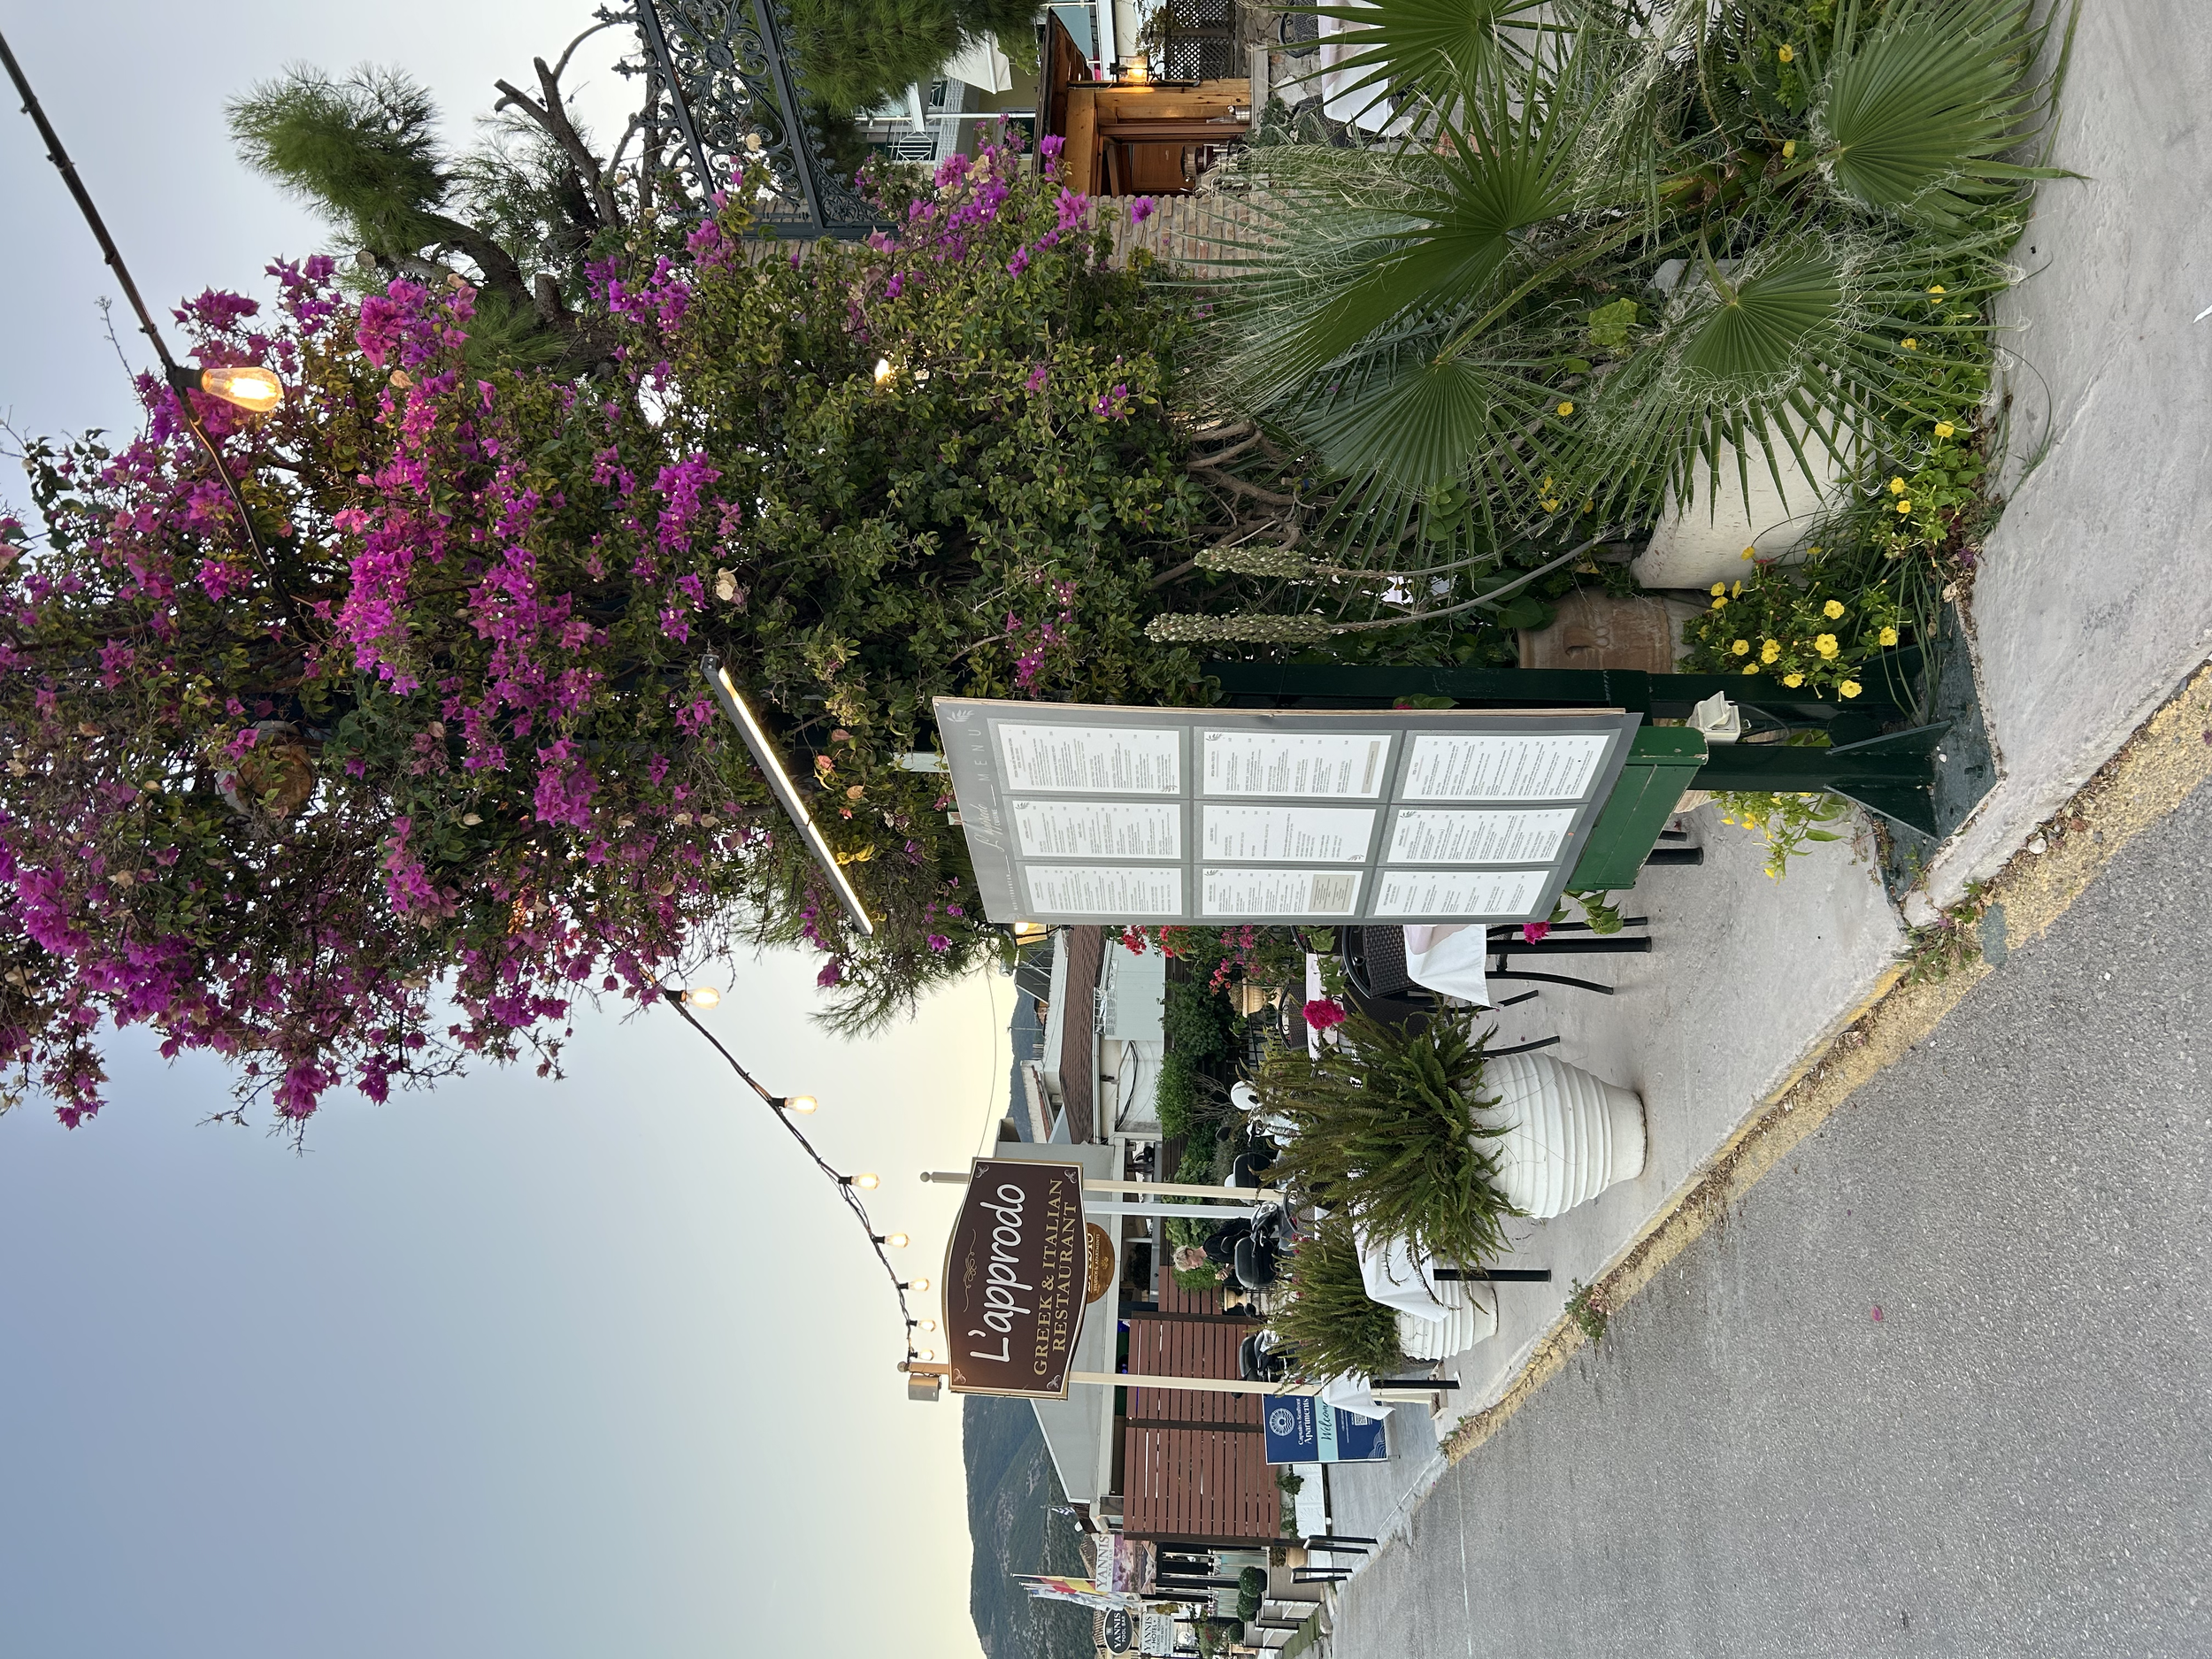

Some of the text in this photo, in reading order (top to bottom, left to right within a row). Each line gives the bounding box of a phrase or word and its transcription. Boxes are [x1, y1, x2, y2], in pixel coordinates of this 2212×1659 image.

[968, 729, 991, 781] MENU
[968, 1184, 1033, 1362] L'approdo
[1033, 1179, 1064, 1375] GREEK & ITALIAN
[1053, 1202, 1077, 1352] RESTAURANT
[1302, 1398, 1313, 1444] Apartments
[1097, 1536, 1110, 1587] YANNIS
[1113, 1612, 1122, 1648] YANNIS
[1143, 1616, 1152, 1651] YANNIS
